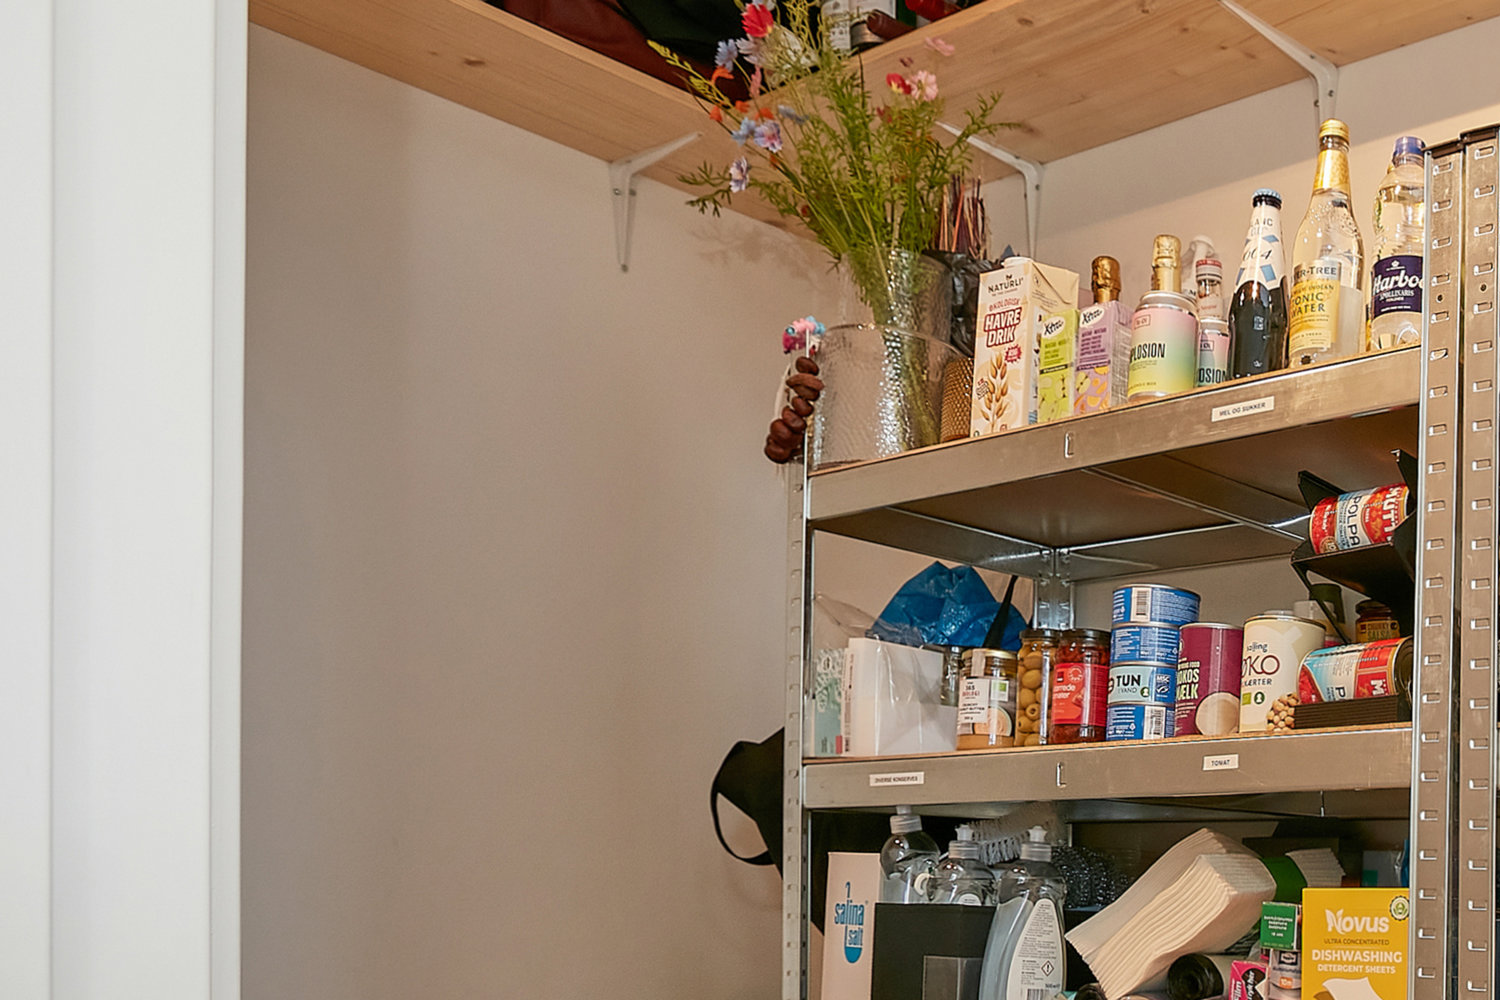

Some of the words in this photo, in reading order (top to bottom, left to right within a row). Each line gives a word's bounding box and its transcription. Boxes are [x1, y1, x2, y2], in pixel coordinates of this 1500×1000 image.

[1373, 270, 1424, 295] Harbo
[985, 308, 1022, 331] HAVRE
[987, 325, 1015, 347] DRIK
[1348, 496, 1361, 546] POLPA
[1116, 674, 1141, 687] TUN
[1156, 674, 1171, 683] MSC
[834, 895, 865, 925] salina
[1343, 938, 1390, 946] CONCENTRATED
[1311, 949, 1403, 963] DISHWASHING
[1317, 964, 1364, 973] DETERGENT
[1365, 965, 1396, 974] SHEETS
